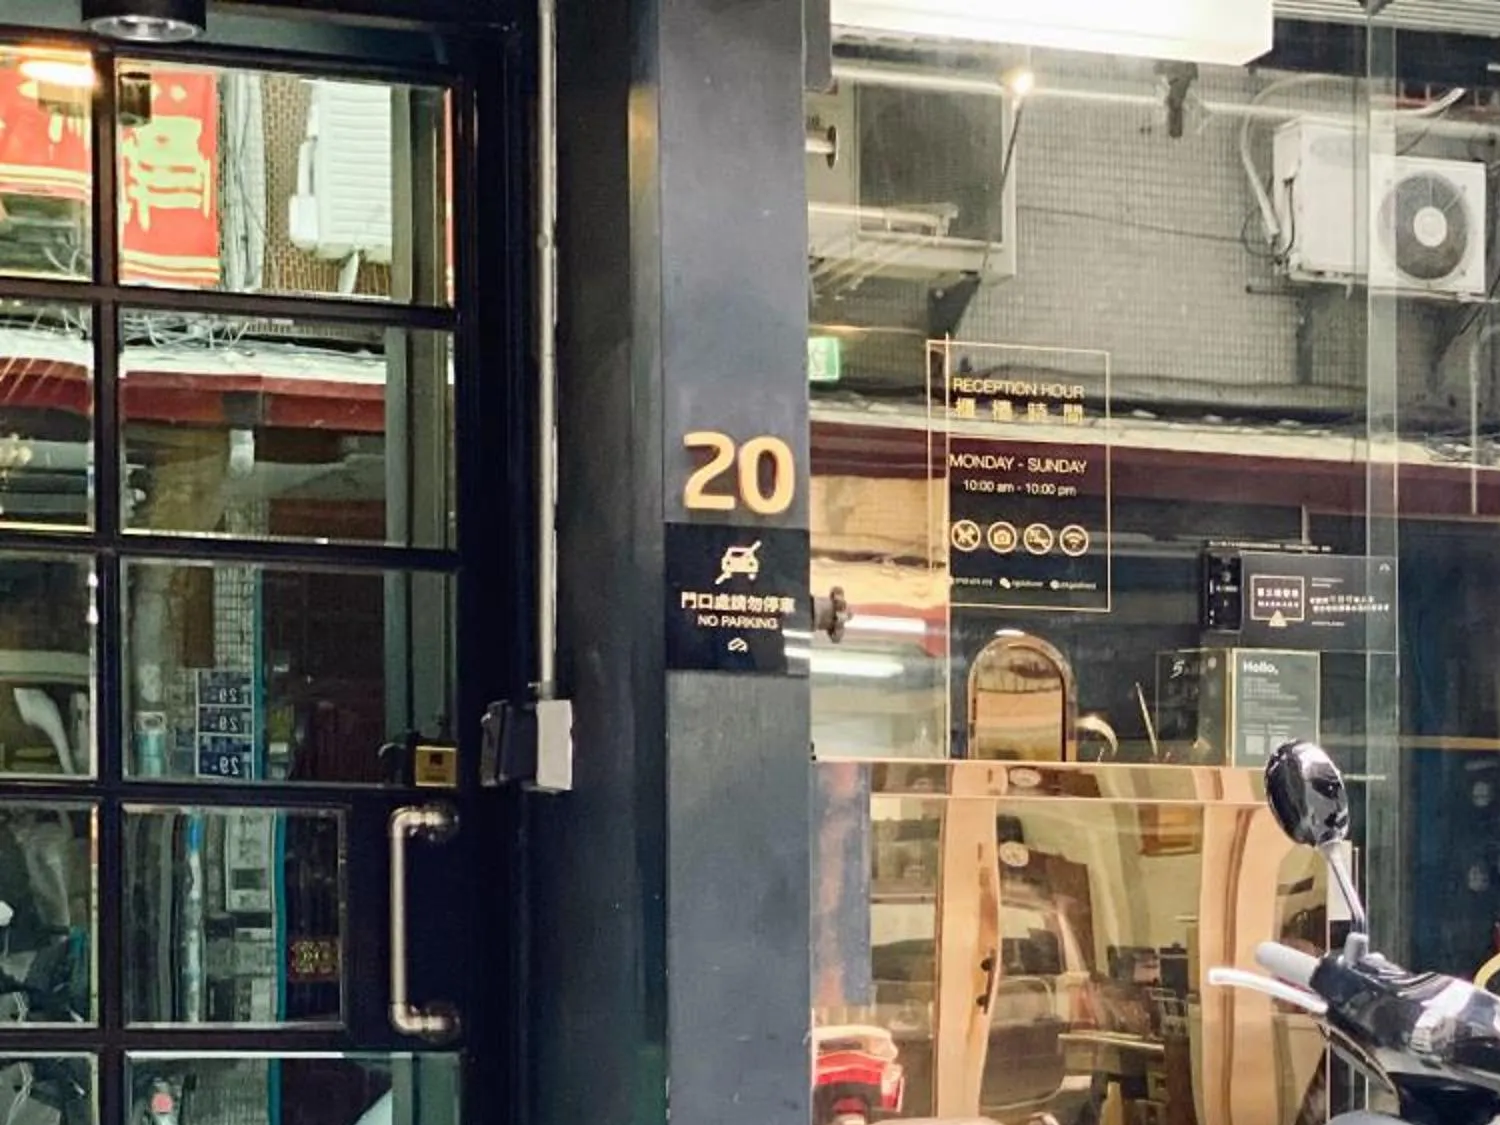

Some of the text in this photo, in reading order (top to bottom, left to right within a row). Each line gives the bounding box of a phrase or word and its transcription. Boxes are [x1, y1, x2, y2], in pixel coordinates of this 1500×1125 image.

[953, 378, 1085, 399] RECEPTION HOUR
[682, 430, 796, 515] 20
[949, 453, 1015, 471] MONDAY
[1027, 457, 1088, 473] SUNDAY
[963, 479, 995, 492] 10:00
[997, 482, 1015, 493] am
[1025, 482, 1056, 495] 10:00
[1057, 485, 1077, 497] pm
[697, 614, 779, 630] NO PARKING
